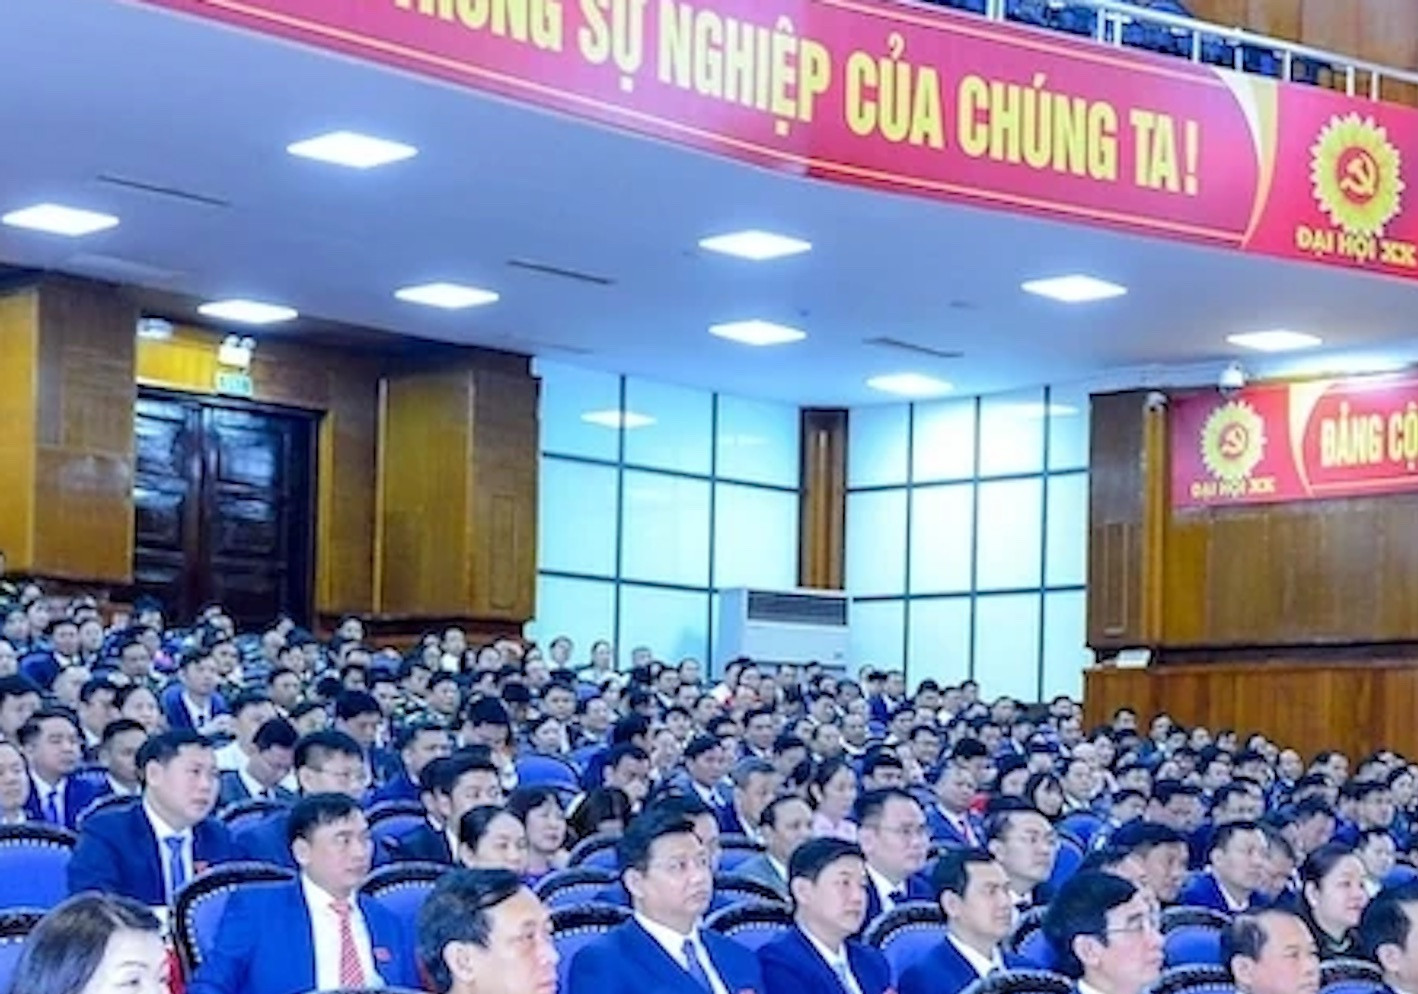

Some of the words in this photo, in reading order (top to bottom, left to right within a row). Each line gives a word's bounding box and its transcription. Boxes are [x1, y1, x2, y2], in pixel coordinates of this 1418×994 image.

[657, 0, 831, 136] NGHIỆP
[845, 32, 944, 149] CỦA
[957, 73, 1117, 182] CHÚNG
[1295, 225, 1334, 257] ĐẠI
[1338, 229, 1376, 264] HỘI
[1321, 400, 1385, 468] ĐẢNG
